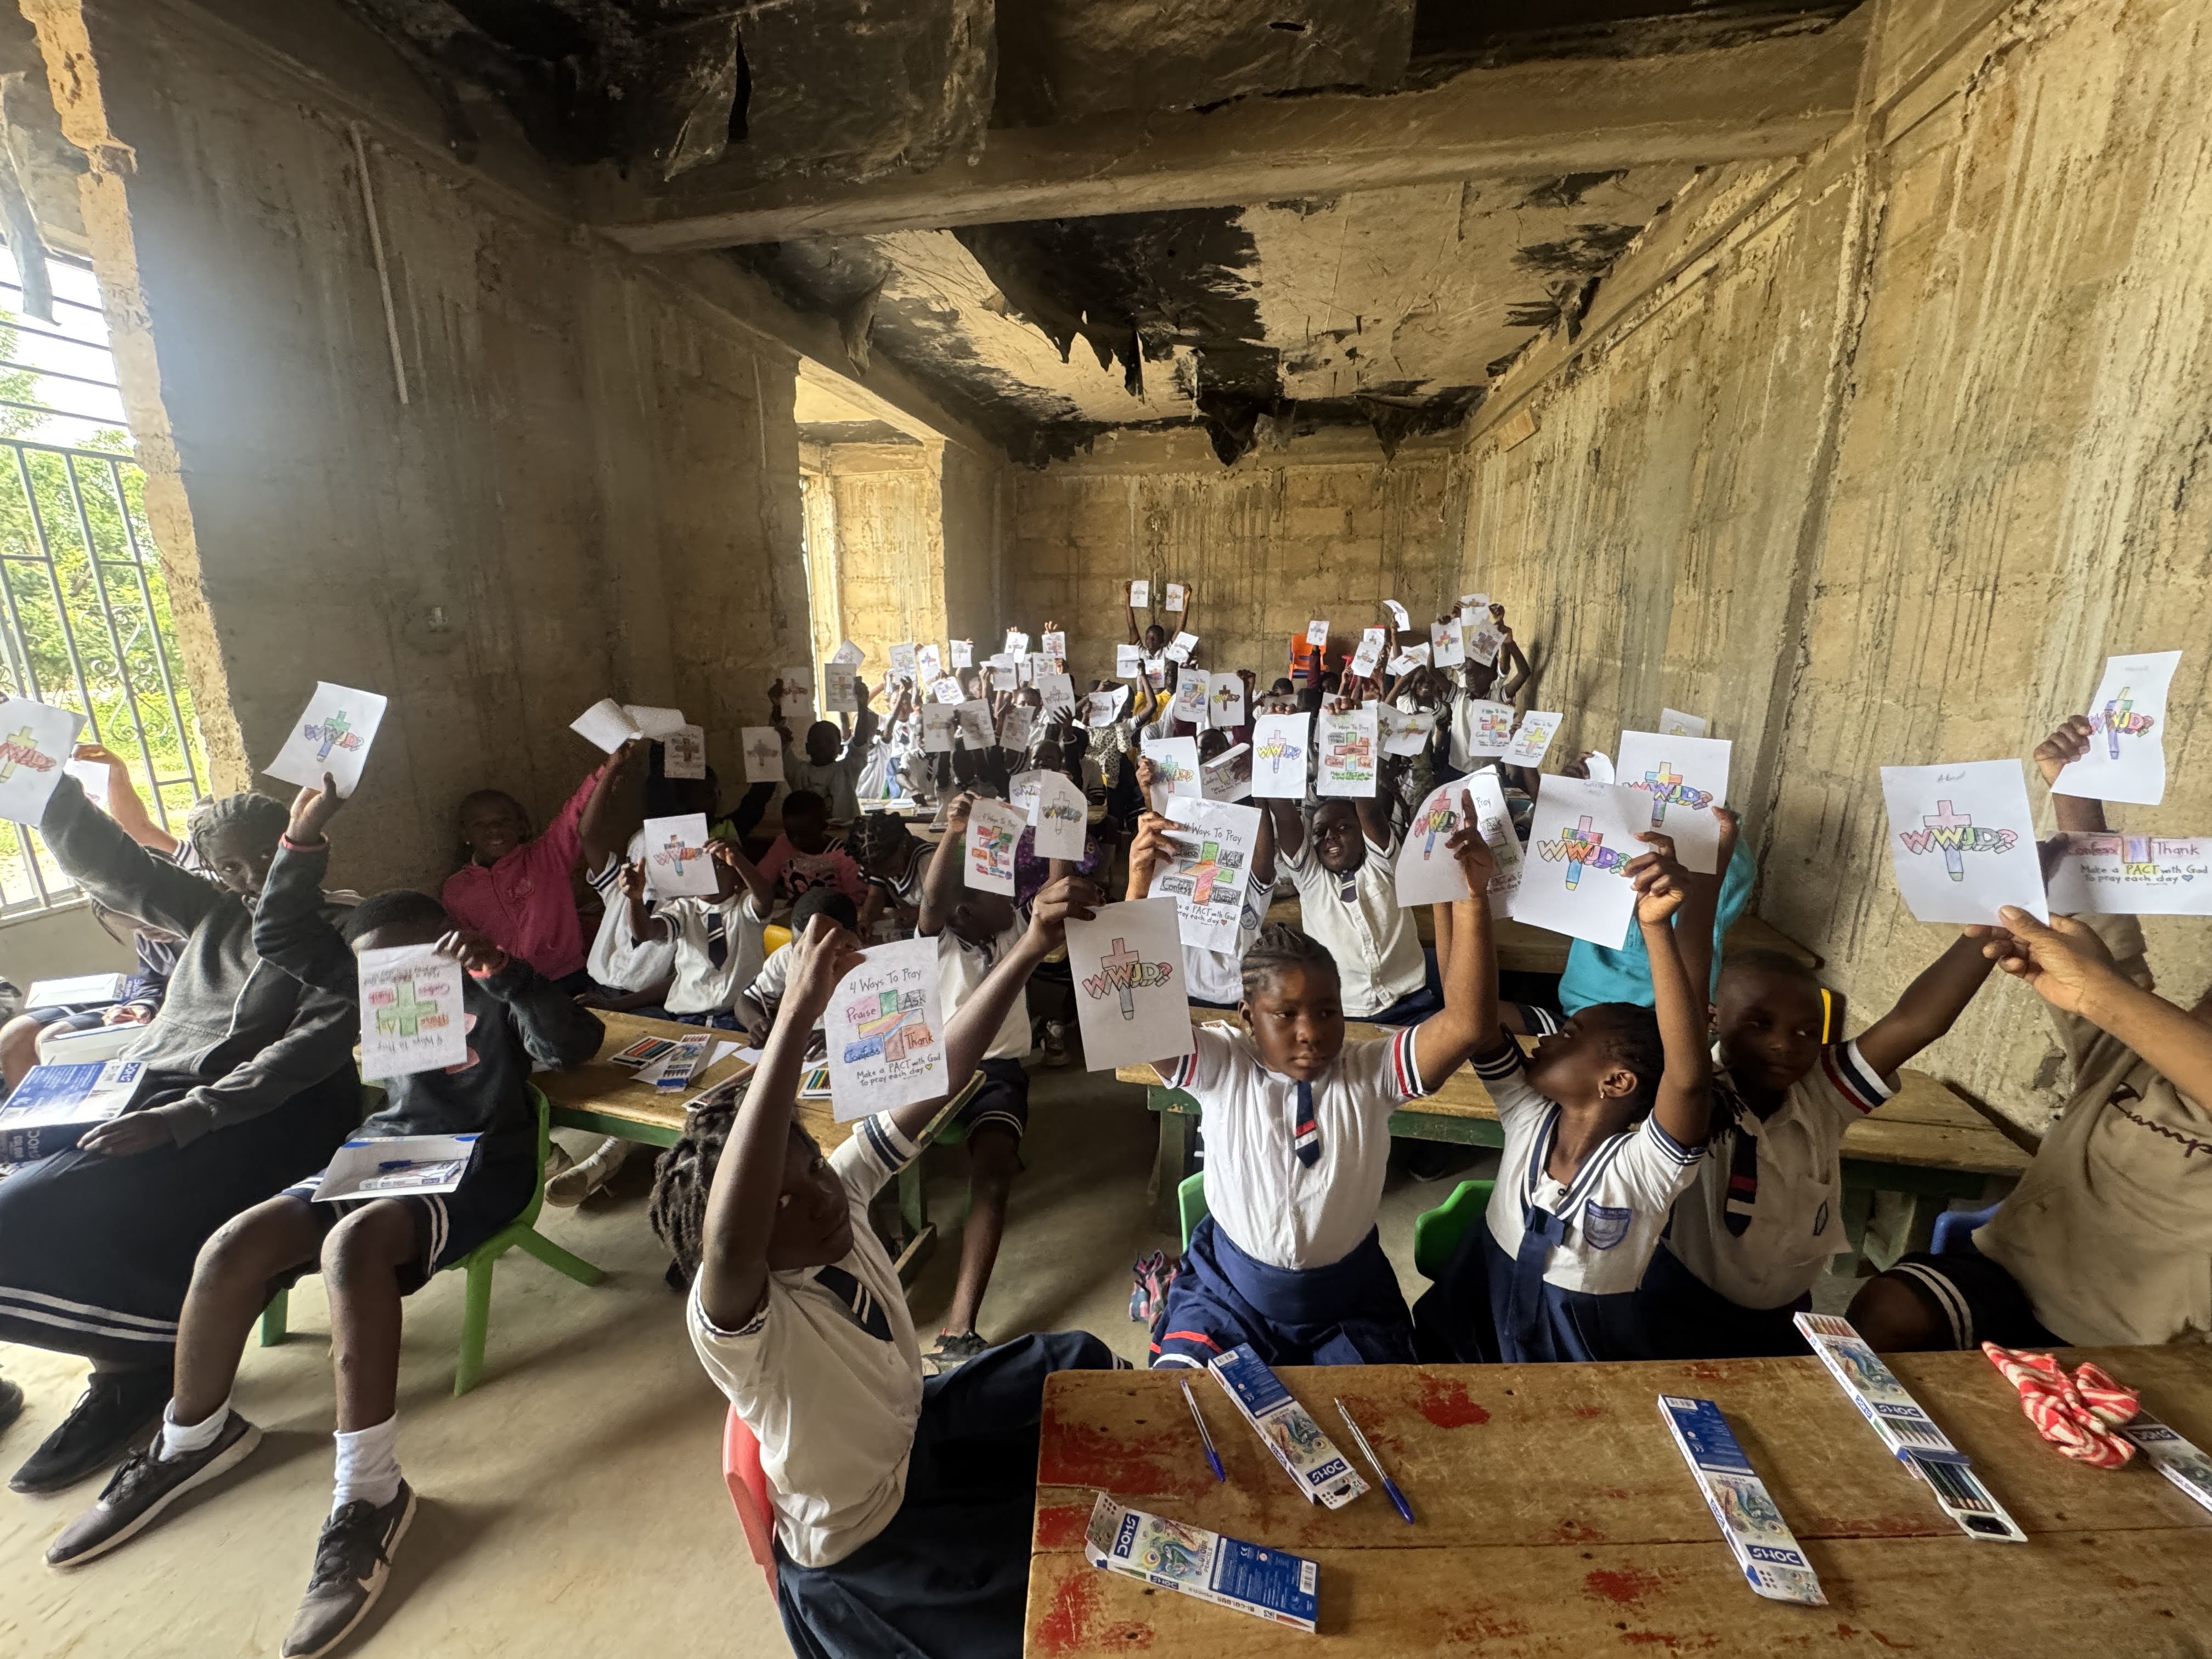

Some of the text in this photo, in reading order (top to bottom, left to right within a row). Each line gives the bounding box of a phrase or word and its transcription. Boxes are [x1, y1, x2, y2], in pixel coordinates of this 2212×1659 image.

[1192, 825, 1210, 836] Ways
[1214, 828, 1223, 838] To
[1226, 830, 1242, 844] Pray
[1899, 826, 2018, 855] WWJD?
[1537, 839, 1633, 874] WWJD?
[2153, 841, 2200, 856] Thank
[2080, 864, 2107, 873] Make
[2126, 864, 2159, 875] PACT
[2160, 865, 2181, 873] with
[2186, 865, 2208, 874] God
[2097, 875, 2121, 884] pray
[2156, 874, 2179, 884] day
[1162, 878, 1192, 894] Confess
[1190, 913, 1205, 923] each
[1206, 917, 1220, 926] day
[1192, 905, 1211, 916] PACT
[1211, 910, 1223, 918] with
[1224, 912, 1237, 921] God
[850, 967, 922, 994] 4 Ways To Pray
[1082, 962, 1173, 999] WWJD?
[846, 991, 926, 1023] Praise Ask
[843, 1031, 934, 1064] Confess Thank
[856, 1069, 876, 1080] Make
[888, 1059, 911, 1074] PACT
[911, 1058, 925, 1067] with
[927, 1053, 941, 1063] God
[870, 1076, 887, 1087] pray
[888, 1071, 906, 1081] each
[910, 1067, 924, 1077] day
[1878, 1404, 1920, 1416] DOMS
[1312, 1460, 1346, 1485] DOMS
[1093, 1533, 1102, 1545] 12
[1119, 1517, 1137, 1556] DOMS
[1204, 1547, 1214, 1573] PENCILS
[1752, 1548, 1801, 1564] DOMS
[1151, 1575, 1178, 1589] DOMS
